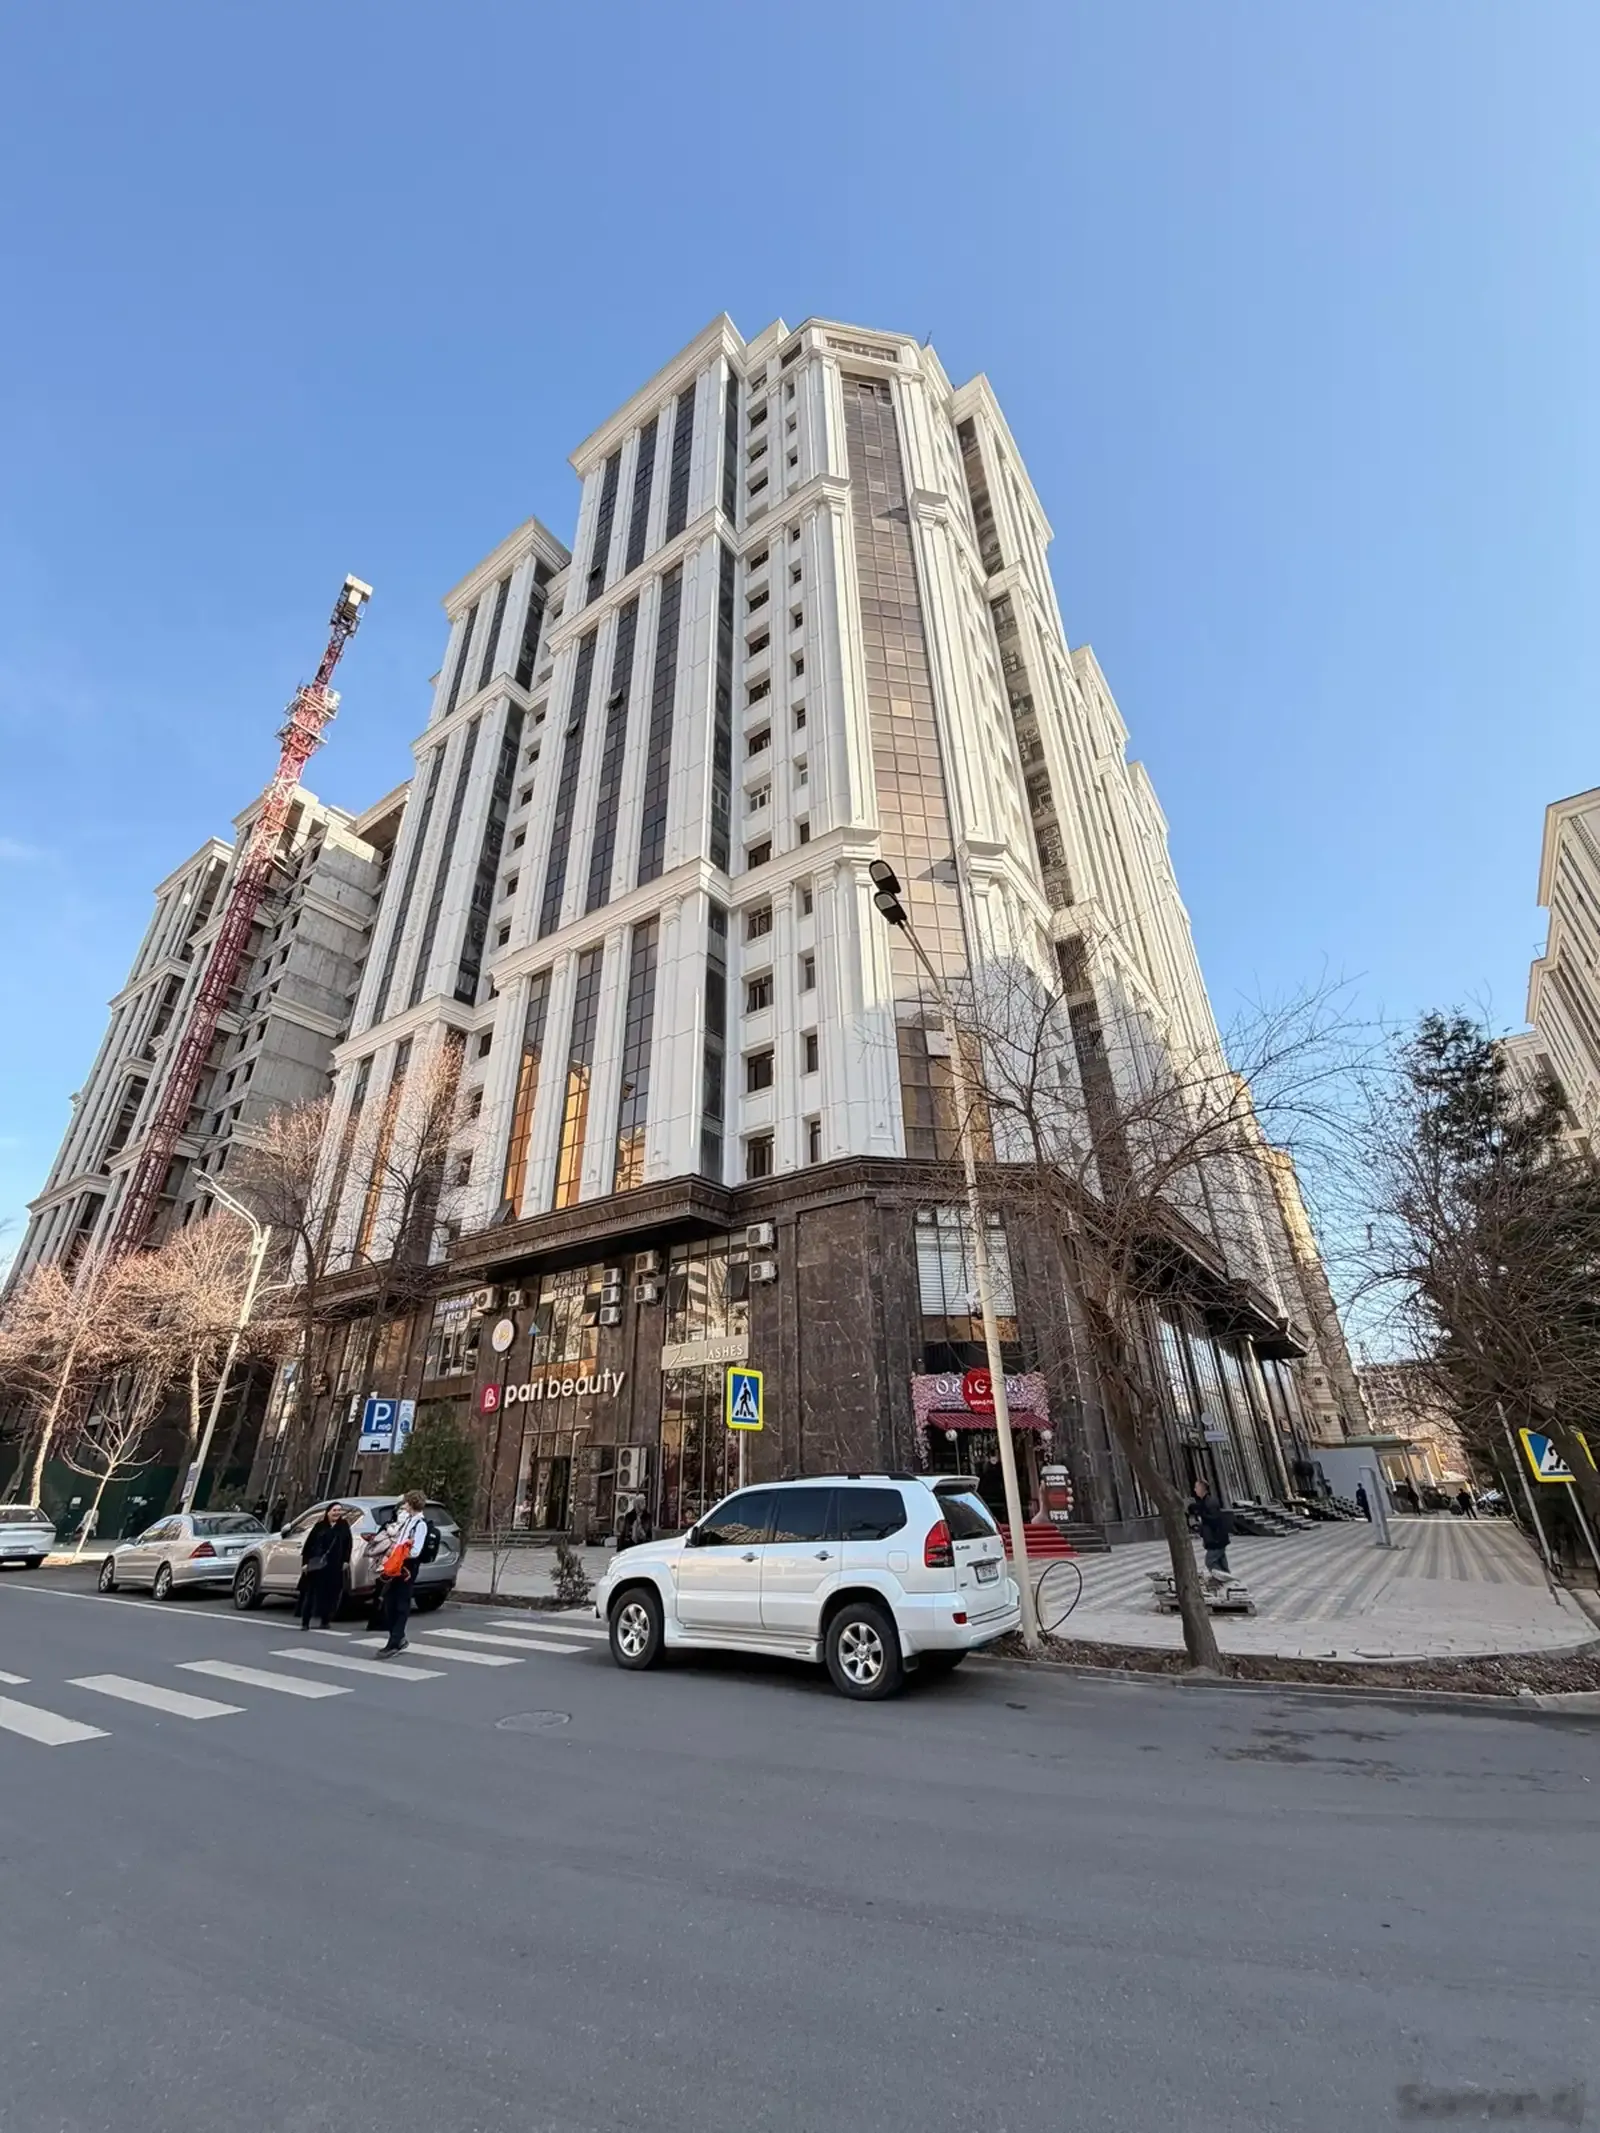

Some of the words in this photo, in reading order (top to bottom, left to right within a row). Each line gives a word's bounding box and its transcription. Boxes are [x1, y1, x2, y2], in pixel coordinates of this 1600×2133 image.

[552, 1284, 585, 1299] BEAUTY
[704, 1340, 744, 1363] LASHES
[504, 1378, 543, 1408] pari
[547, 1368, 625, 1399] beauty
[936, 1379, 1025, 1395] ORIGMI
[371, 1403, 391, 1430] P
